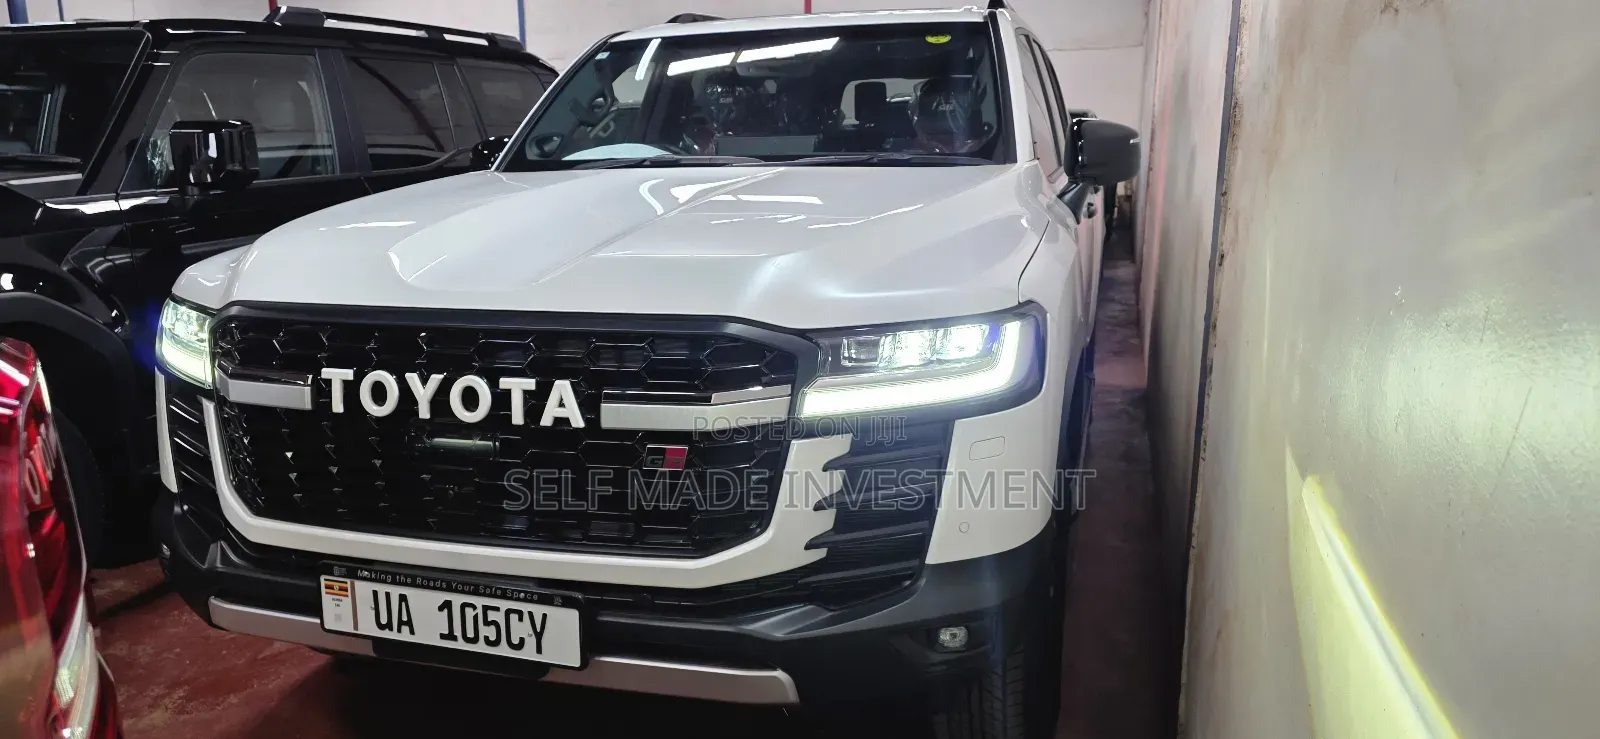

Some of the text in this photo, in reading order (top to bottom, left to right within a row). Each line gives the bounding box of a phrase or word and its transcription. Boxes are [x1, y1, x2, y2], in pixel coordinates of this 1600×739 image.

[321, 368, 586, 428] TOYOTA
[357, 569, 539, 602] Making the Roads Your Safe Space
[372, 589, 548, 655] UA 105CY
